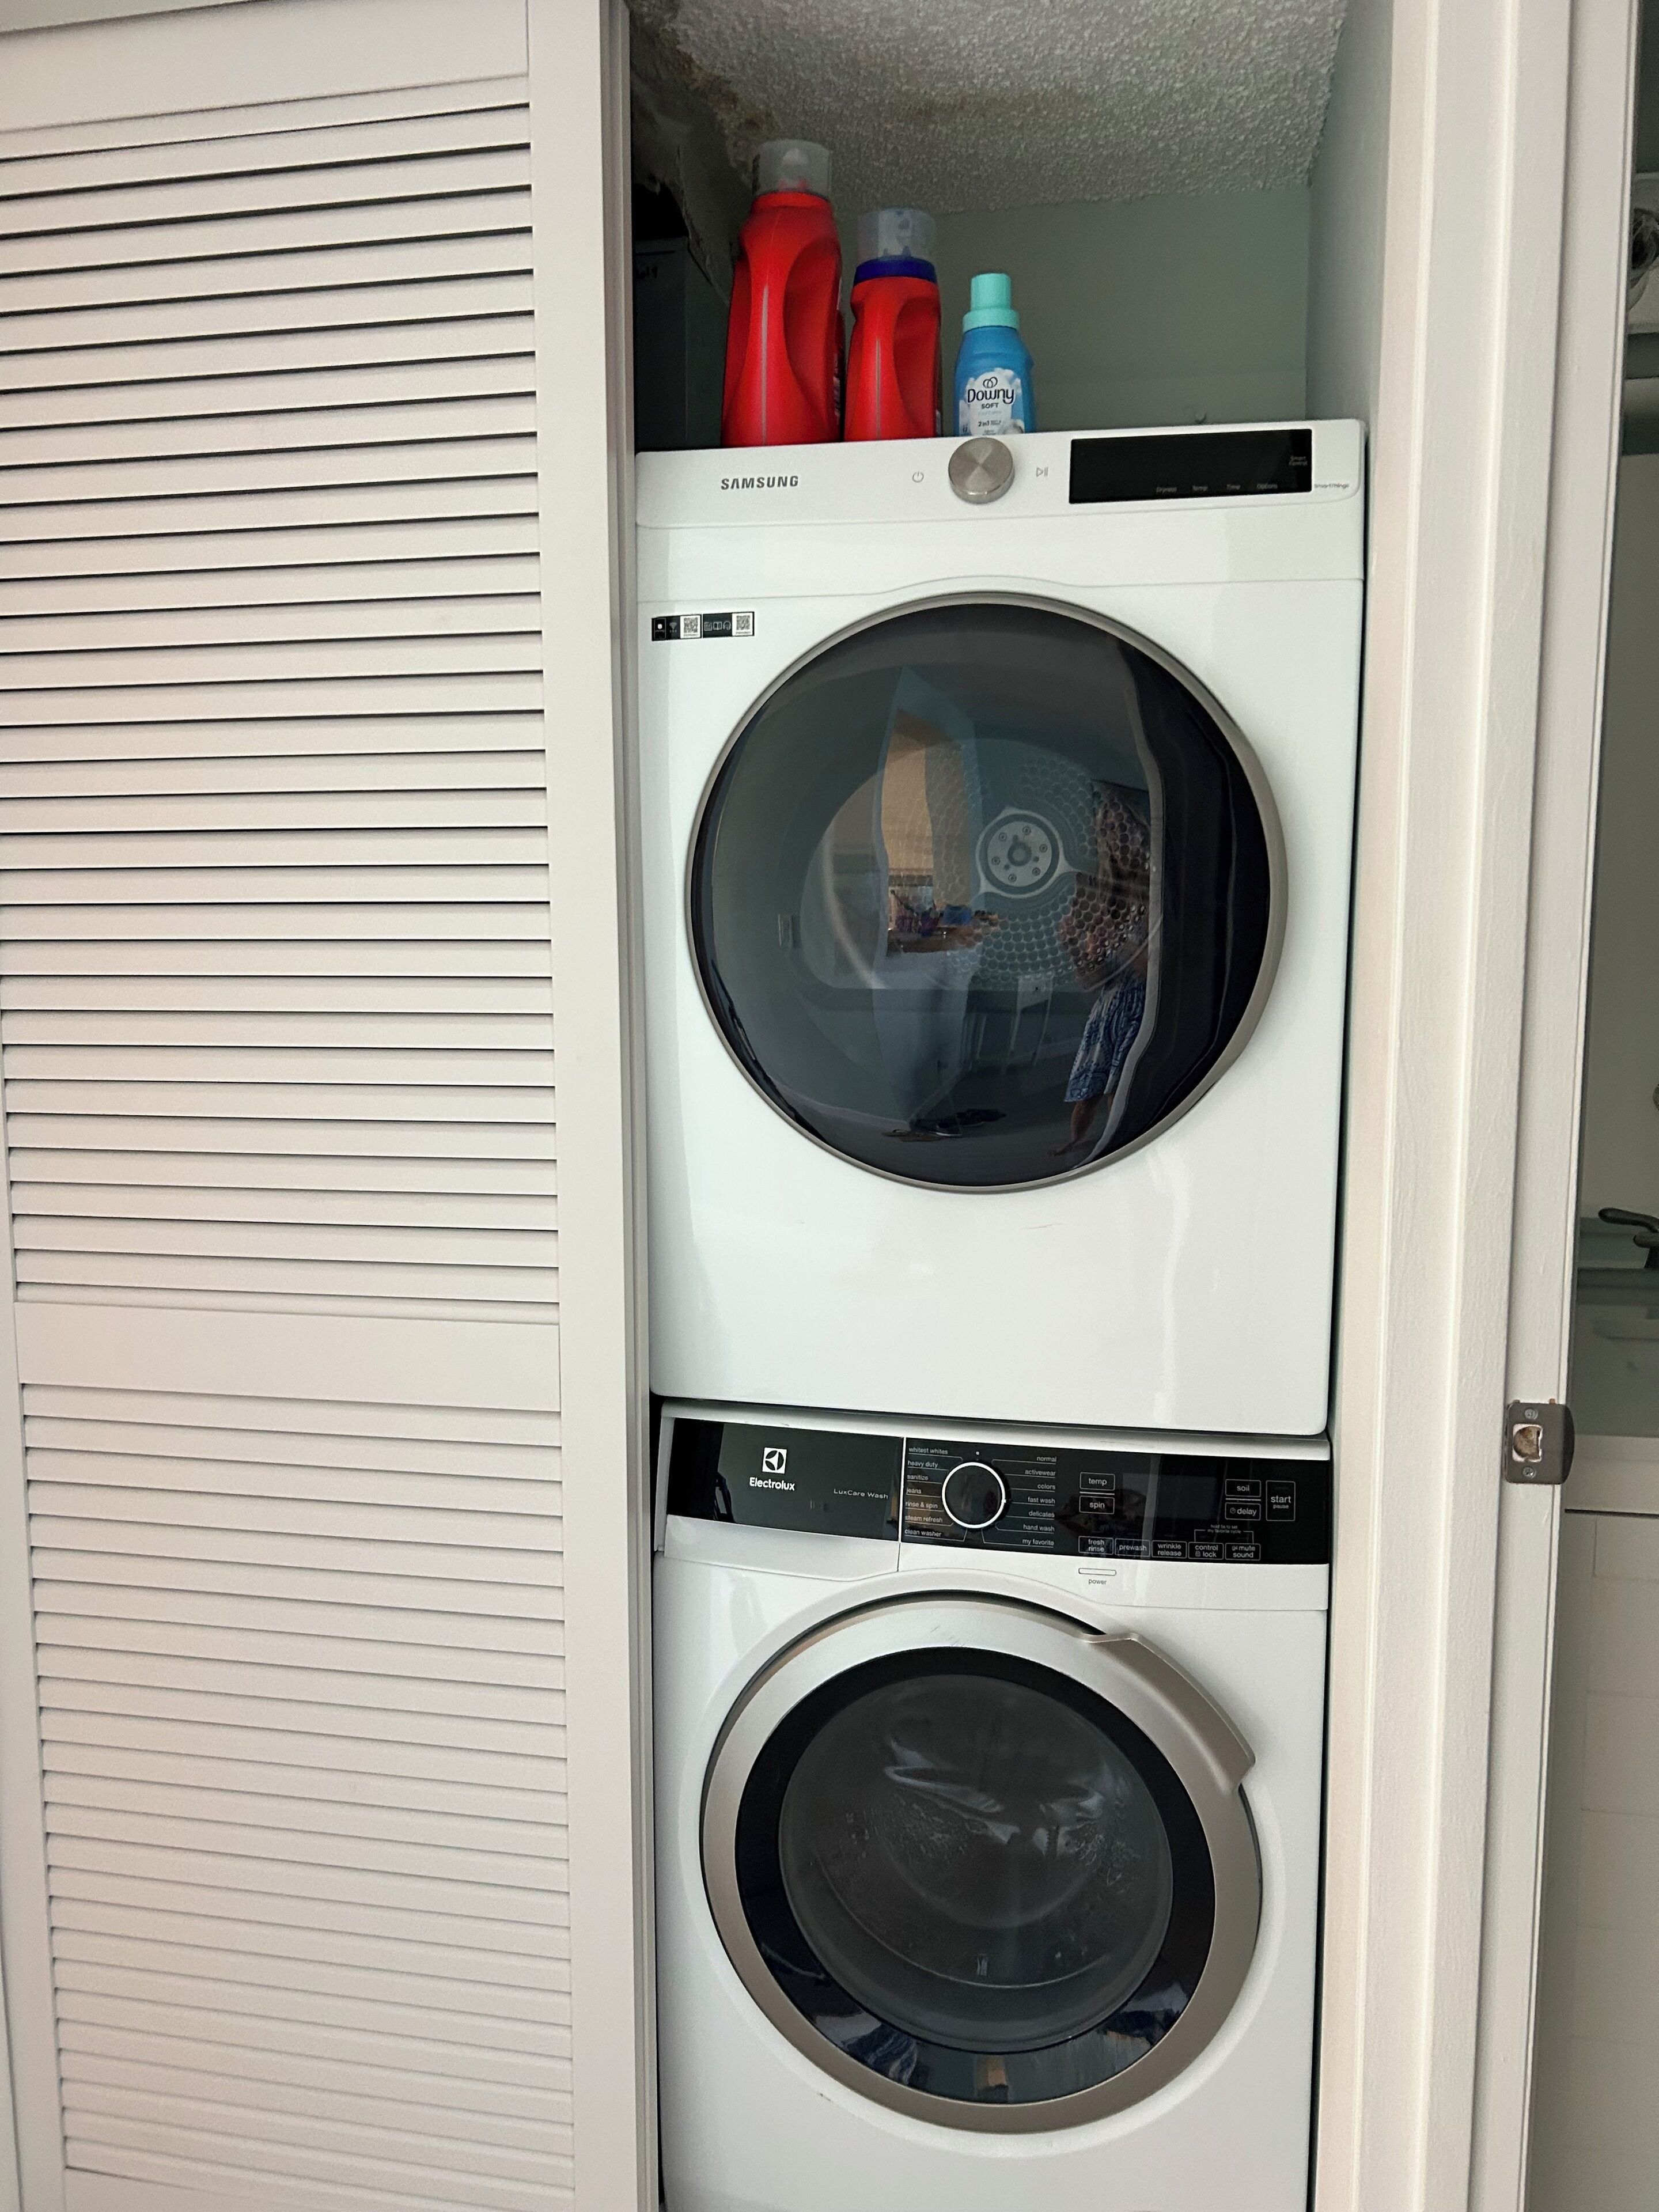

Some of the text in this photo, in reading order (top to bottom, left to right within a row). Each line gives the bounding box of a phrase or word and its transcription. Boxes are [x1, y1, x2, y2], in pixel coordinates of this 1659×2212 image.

[968, 388, 1014, 404] Downy
[721, 476, 798, 490] SAMSUNG
[749, 1476, 796, 1491] Electrolux
[1088, 1478, 1107, 1486] temp
[834, 1488, 888, 1499] LuxCare Wash
[1271, 1495, 1291, 1503] start
[1237, 1508, 1257, 1516] delay
